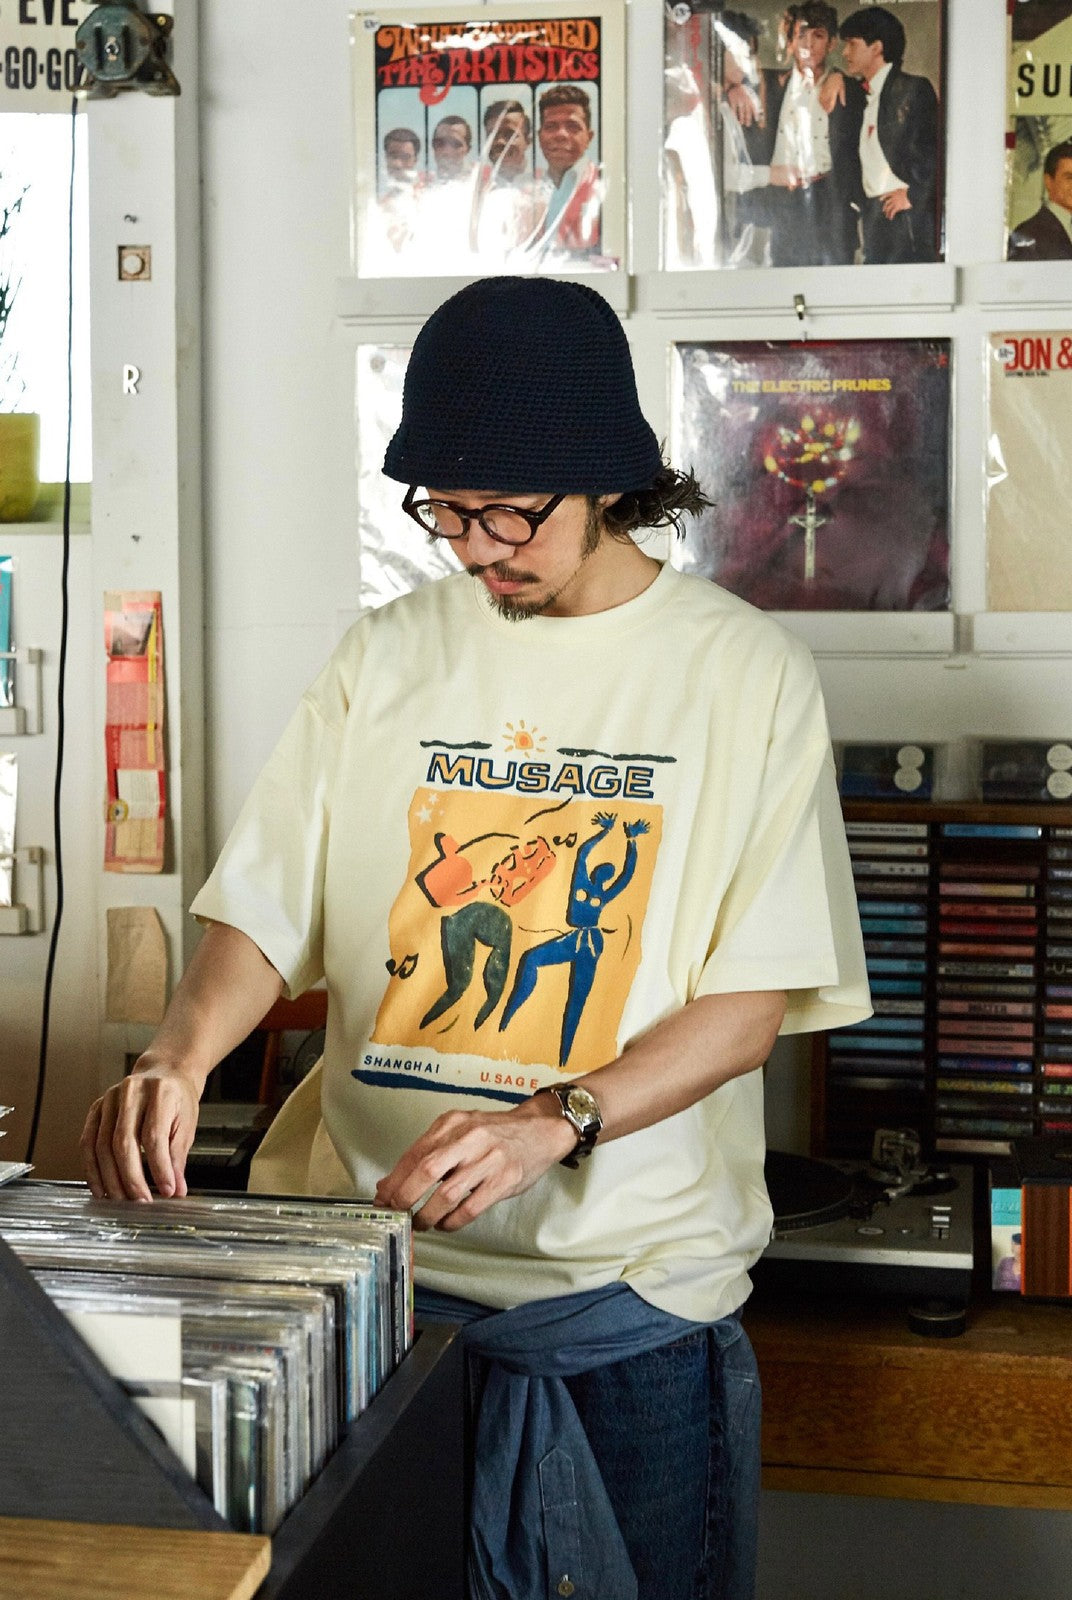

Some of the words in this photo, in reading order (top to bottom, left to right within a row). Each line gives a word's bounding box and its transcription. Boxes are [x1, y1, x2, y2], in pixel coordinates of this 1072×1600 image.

[378, 53, 445, 87] THE
[420, 43, 599, 105] ARTISTICS
[1018, 63, 1072, 97] SU
[123, 364, 140, 395] R
[732, 379, 760, 393] THE
[762, 379, 831, 393] ELECTRIC
[833, 378, 892, 393] PRUNES
[426, 752, 655, 799] MUSAGE
[364, 1055, 440, 1074] SHANGHAI
